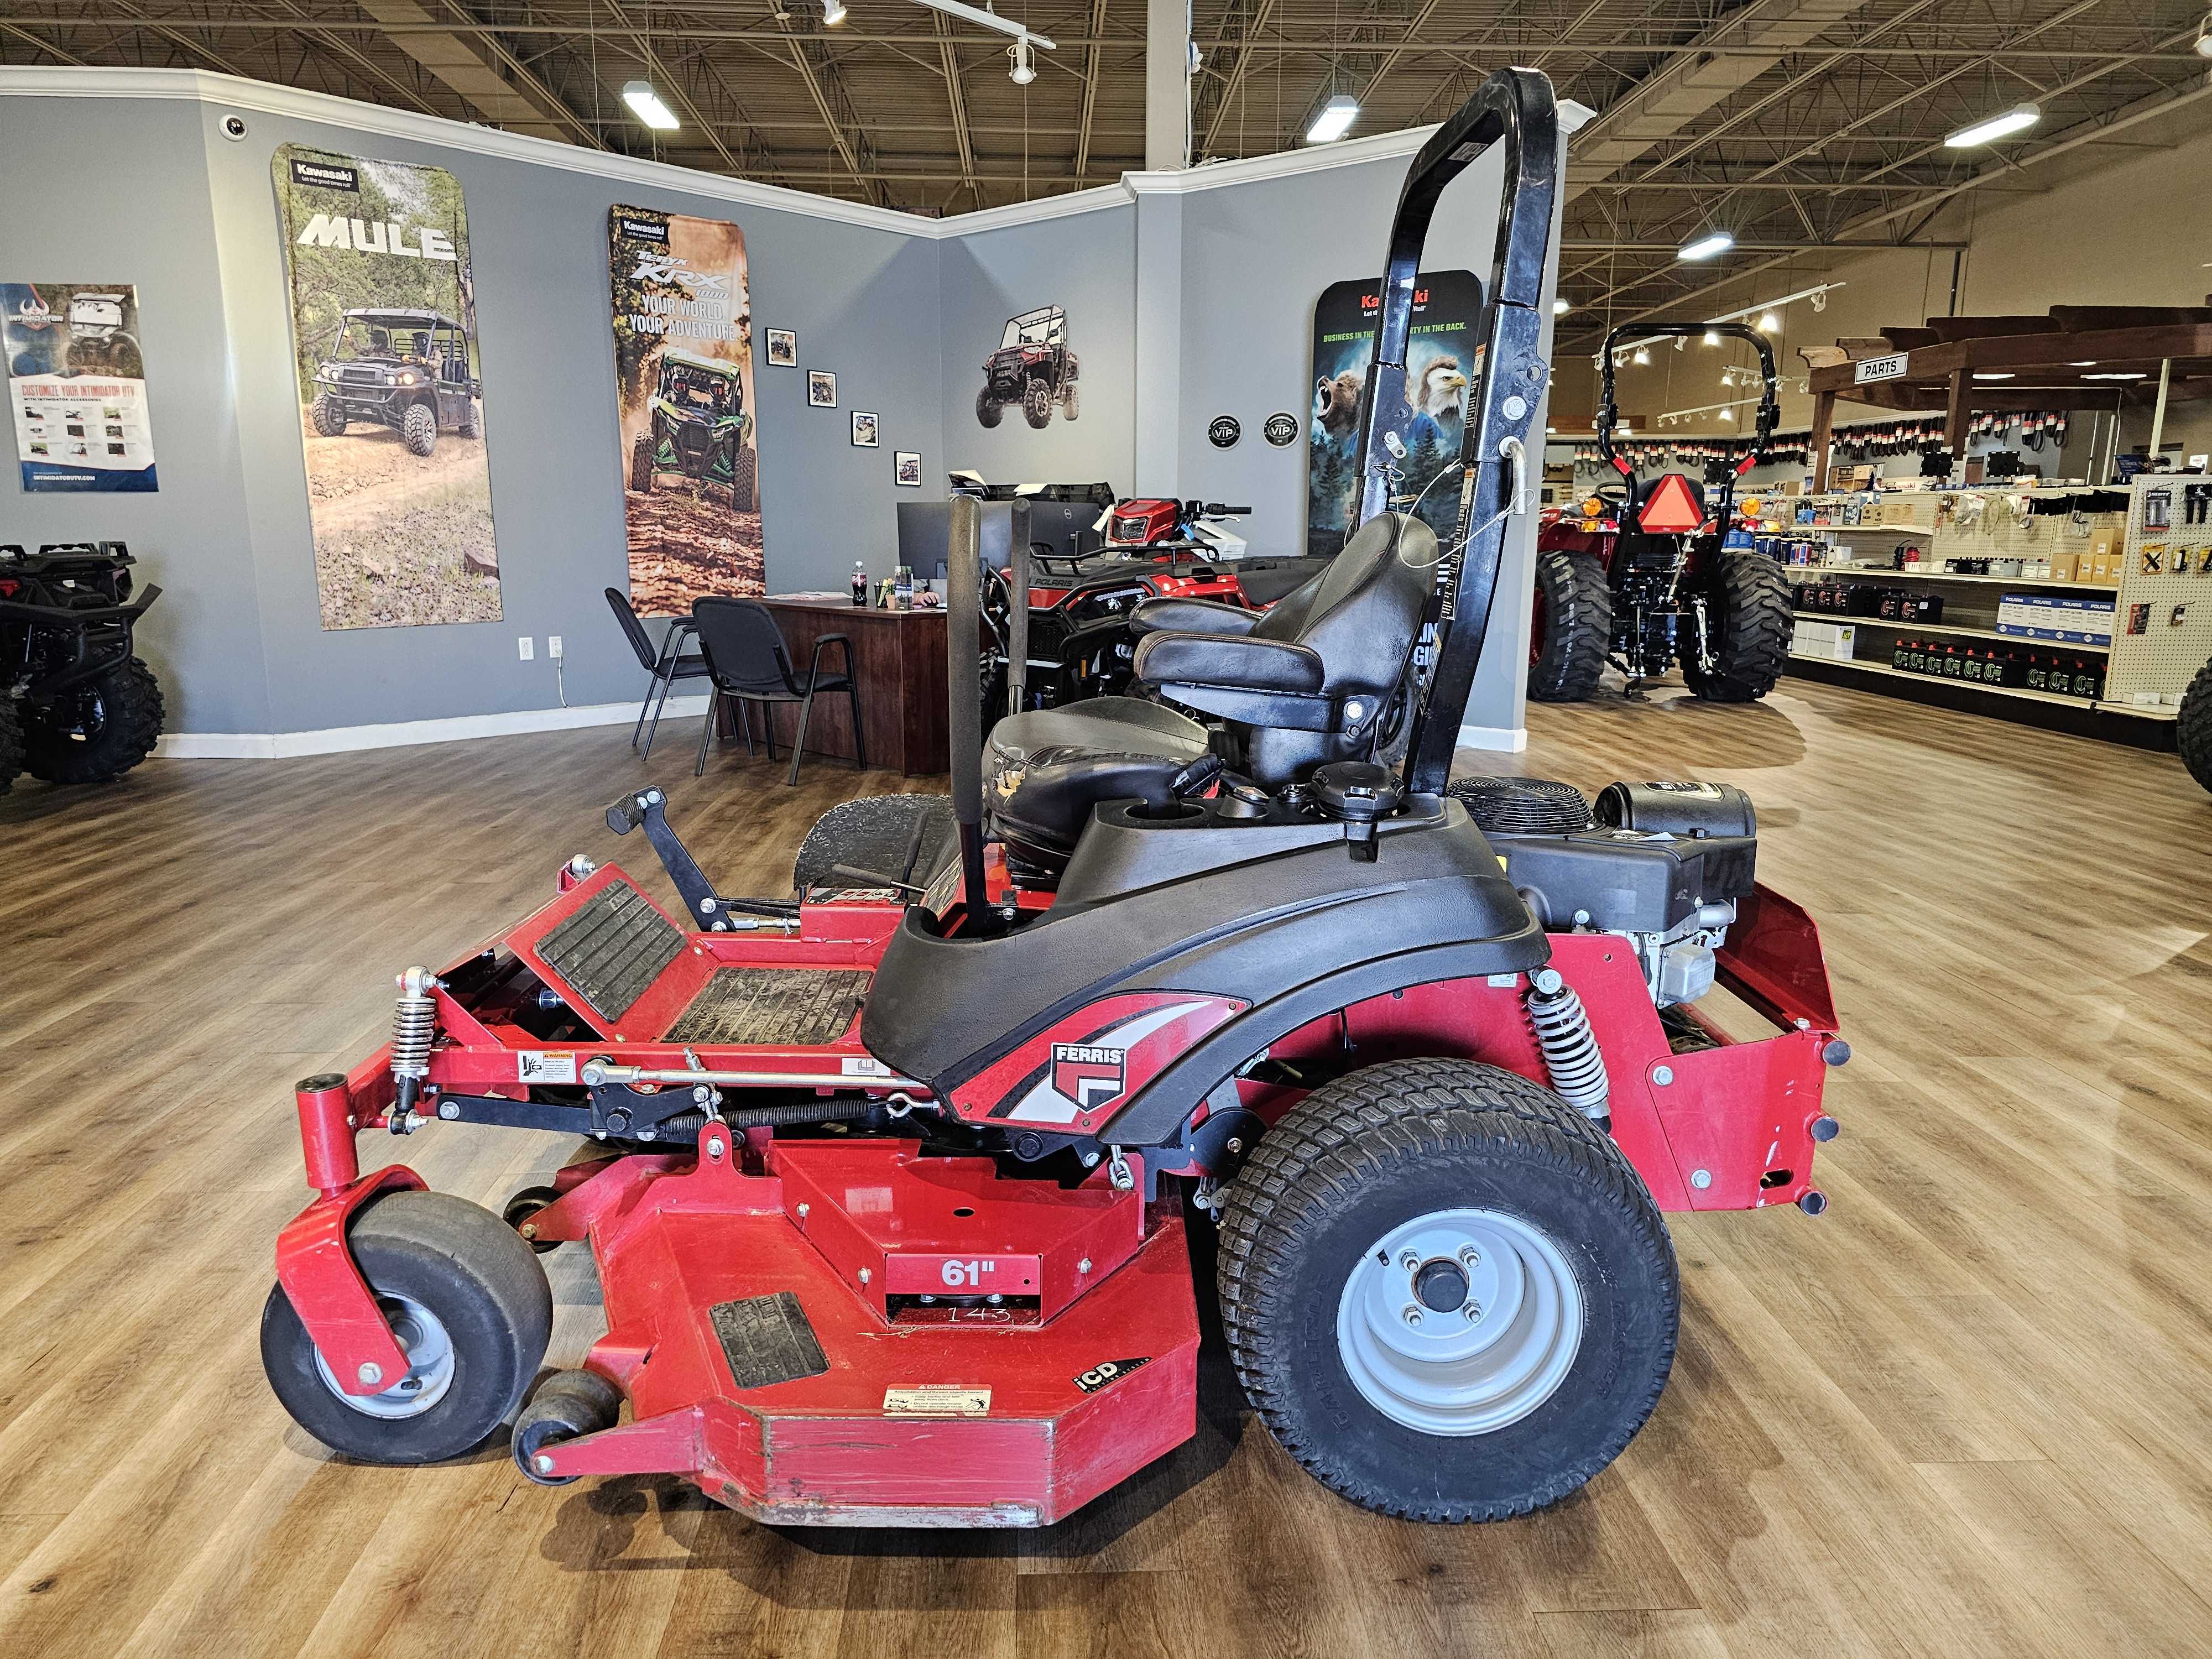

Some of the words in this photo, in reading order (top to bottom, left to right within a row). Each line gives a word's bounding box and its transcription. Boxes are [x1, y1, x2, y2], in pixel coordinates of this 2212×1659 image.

[297, 163, 352, 181] Kawasaki
[624, 221, 664, 235] Kawasaki
[296, 213, 458, 261] MULE
[629, 263, 730, 290] KRX
[696, 289, 729, 299] 1000
[641, 294, 676, 315] YOUR
[680, 299, 726, 320] WORLD.
[629, 314, 664, 335] YOUR
[667, 320, 738, 341] ADVENTURE.
[1323, 333, 1354, 342] BUSINESS
[1446, 322, 1467, 331] BACK.
[1865, 361, 1896, 377] PARTS
[22, 384, 58, 396] CUSTOMIZE
[61, 385, 78, 396] YOUR
[80, 386, 120, 397] INTIMIDATOR
[122, 387, 134, 397] UTV
[1215, 429, 1233, 437] VIP
[1271, 426, 1290, 436] VIP
[1035, 578, 1073, 587] POLARIS
[1057, 1047, 1121, 1064] FERRIS
[942, 1260, 994, 1286] 61"
[1073, 1363, 1118, 1390] iCD
